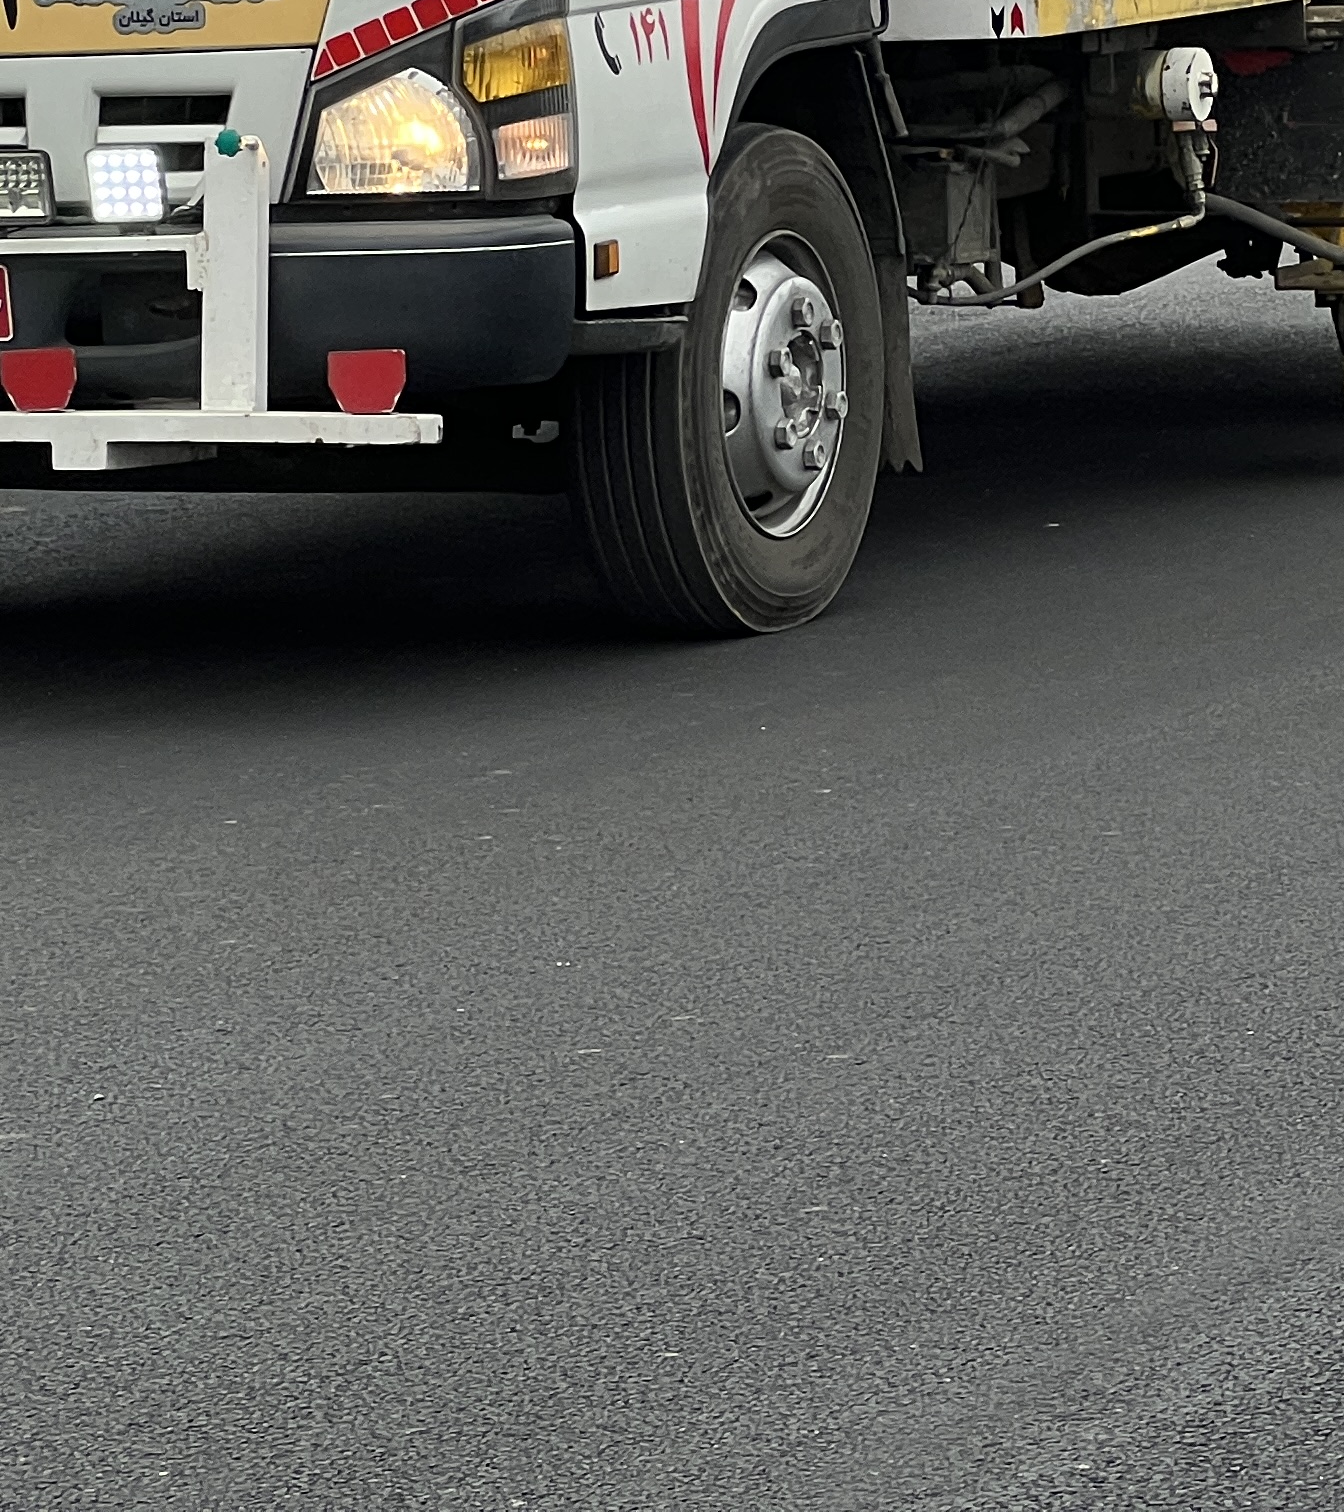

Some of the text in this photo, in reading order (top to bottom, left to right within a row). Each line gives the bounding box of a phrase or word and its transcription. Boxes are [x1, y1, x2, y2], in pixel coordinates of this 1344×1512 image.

[118, 8, 200, 28] استان گیلان
[629, 6, 670, 67] ۱۴۱
